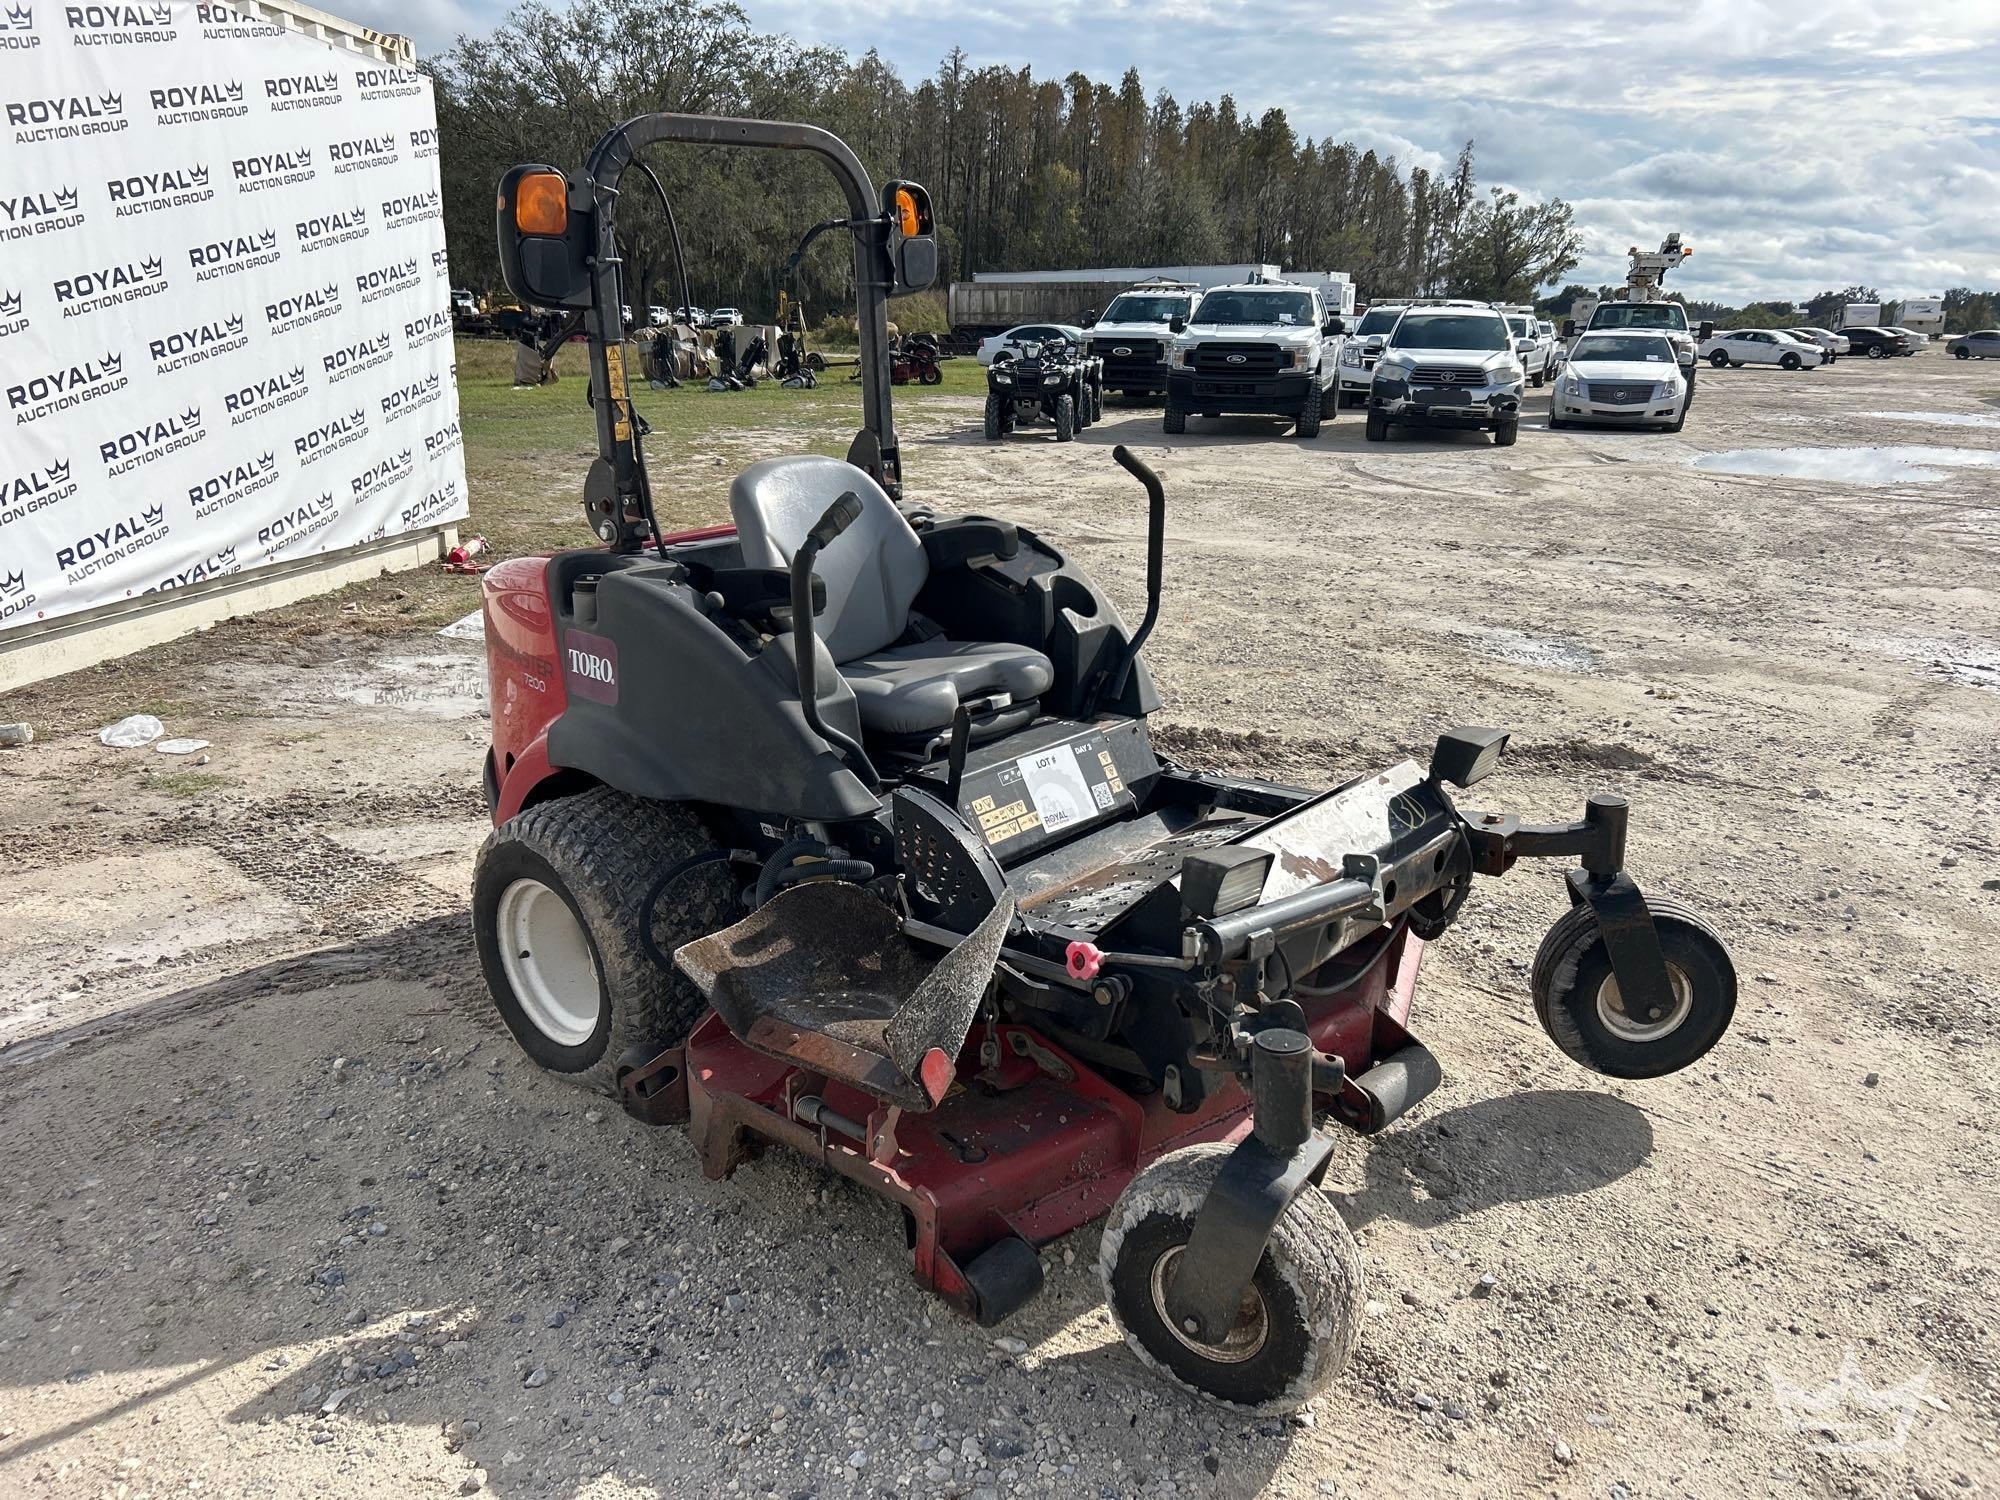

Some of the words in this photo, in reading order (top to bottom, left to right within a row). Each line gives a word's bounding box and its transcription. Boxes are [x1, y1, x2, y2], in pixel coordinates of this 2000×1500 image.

[65, 5, 153, 28] ROYAL
[196, 5, 262, 24] ROY
[0, 36, 41, 50] ROUP
[73, 32, 133, 46] AUCTION
[135, 31, 177, 43] GROUP
[203, 28, 250, 39] AUCTION
[252, 27, 286, 37] GROUP
[265, 75, 325, 97] ROYAL
[356, 68, 407, 88] ROYAL
[150, 84, 226, 109] ROYAL
[271, 98, 311, 112] AUCTION
[312, 95, 342, 105] GROUP
[361, 90, 394, 101] AUCTION
[396, 87, 421, 96] GROUP
[6, 96, 101, 125] ROYAL
[157, 110, 210, 125] AUCTION
[211, 106, 248, 120] GROUP
[16, 125, 80, 144] AUCTION
[82, 120, 128, 135] GROUP
[410, 128, 438, 147] ROY
[329, 138, 383, 161] ROYAL
[414, 148, 438, 159] AUCTIO
[232, 152, 297, 178] ROYAL
[334, 161, 371, 174] AUCTION
[372, 155, 398, 166] GROUP
[107, 171, 191, 201] ROYAL
[239, 178, 282, 194] AUCTION
[284, 171, 315, 184] GROUP
[0, 194, 57, 220] YAL
[116, 200, 171, 217] AUCTION
[173, 190, 214, 205] GROUP
[382, 194, 428, 218] ROYAL
[0, 227, 32, 242] TION
[35, 214, 85, 233] GROUP
[296, 212, 352, 240] ROYAL
[387, 215, 418, 230] AUCTION
[419, 209, 440, 222] GROUP
[189, 236, 261, 267] ROYAL
[301, 236, 339, 254] AUCTION
[340, 228, 369, 243] GROUP
[196, 261, 244, 282] AUCTION
[246, 252, 281, 268] GROUP
[356, 264, 406, 292] ROYAL
[54, 264, 143, 302] ROYAL
[361, 286, 395, 305] AUCTION
[396, 277, 421, 291] GROUP
[63, 293, 122, 319] AUCTION
[125, 281, 169, 301] GROUP
[266, 291, 325, 322] ROYAL
[0, 318, 29, 336] OUP
[271, 314, 312, 336] AUCTION
[313, 304, 342, 321] GROUP
[405, 310, 448, 339] ROYAL
[149, 322, 227, 360] ROYAL
[408, 329, 439, 350] AUCTION
[441, 326, 451, 339] GRO
[157, 349, 209, 375] AUCTION
[211, 337, 248, 356] GROUP
[323, 339, 378, 372] ROYAL
[329, 362, 365, 385] AUCTION
[366, 351, 393, 368] GROUP
[7, 363, 102, 409] ROYAL
[225, 375, 291, 412] ROYAL
[381, 380, 426, 413] ROYAL
[16, 394, 80, 426] AUCTION
[82, 377, 128, 401] GROUP
[232, 402, 276, 426] AUCTION
[277, 387, 309, 407] GROUP
[386, 403, 418, 424] AUCTION
[418, 391, 442, 407] GROUP
[100, 418, 182, 463] ROYAL
[295, 418, 352, 455] ROYAL
[301, 442, 338, 468] AUCTION
[339, 427, 369, 448] GROUP
[425, 422, 459, 451] ROYA
[108, 447, 164, 478] AUCTION
[166, 430, 206, 453] GROUP
[0, 472, 48, 506] YAL
[189, 462, 260, 506] ROYAL
[351, 458, 400, 494] ROYAL
[355, 479, 387, 506] AUCTION
[388, 466, 413, 485] GROUP
[28, 483, 77, 512] GROUP
[196, 488, 243, 520] AUCTION
[245, 471, 279, 495] GROUP
[402, 489, 446, 525] ROYAL
[437, 497, 458, 517] GROUP
[258, 502, 320, 546] ROYAL
[264, 532, 307, 557] AUCTION
[308, 511, 339, 533] GROUP
[56, 517, 145, 571] ROYAL
[68, 548, 125, 586] AUCTION
[127, 526, 169, 553] GROUP
[1035, 757, 1051, 769] LOT
[1074, 744, 1087, 755] DAY
[1044, 811, 1068, 824] ROYAL
